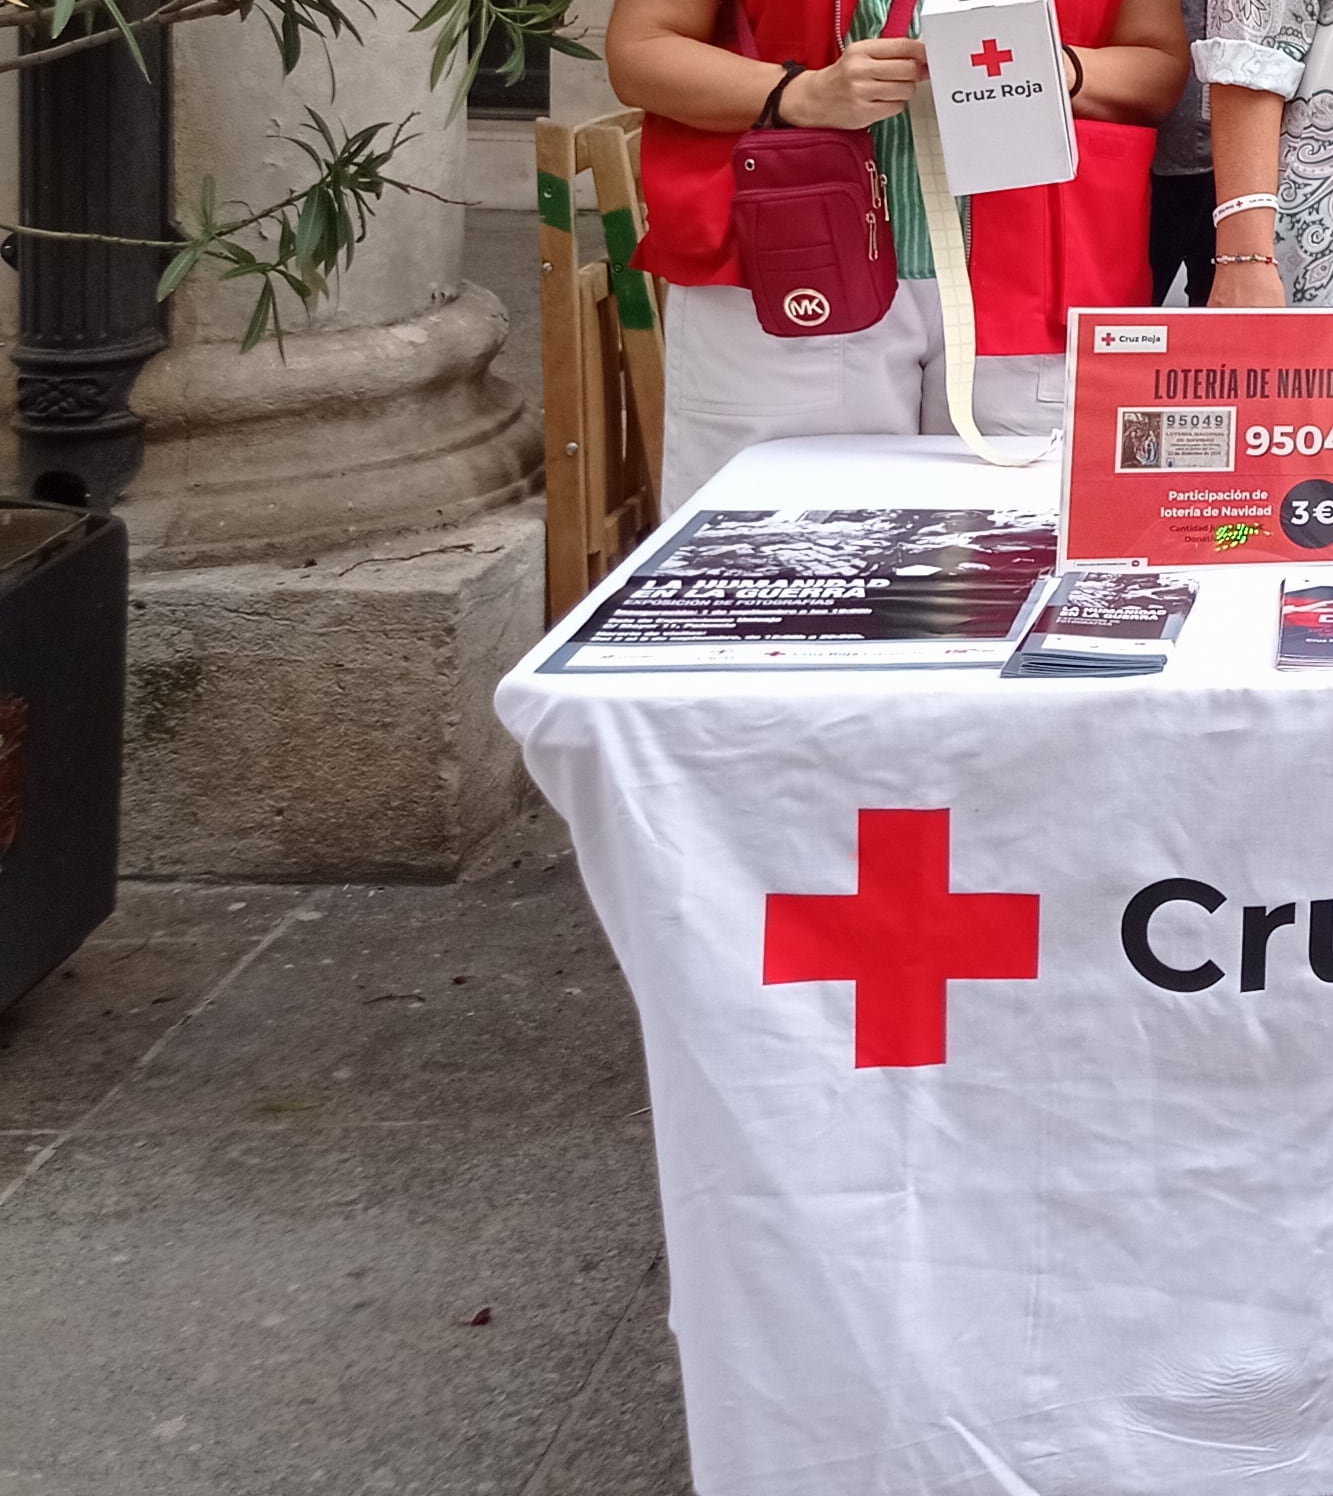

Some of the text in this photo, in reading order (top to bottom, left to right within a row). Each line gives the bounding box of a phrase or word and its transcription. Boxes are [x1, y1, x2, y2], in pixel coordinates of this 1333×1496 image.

[951, 80, 1043, 103] Cruz Roja
[790, 298, 824, 316] MK
[1119, 334, 1161, 344] Cruz Roja
[1154, 364, 1239, 399] LOTERÍA
[1246, 369, 1270, 399] DE
[1166, 415, 1224, 427] 95049
[1168, 489, 1268, 503] Participación de
[1160, 505, 1272, 518] lotería de Navidad
[640, 578, 891, 590] LA HUMANIDAD
[630, 587, 867, 599] EN LA GUERRA
[622, 598, 711, 606] EXPOSICIÓN
